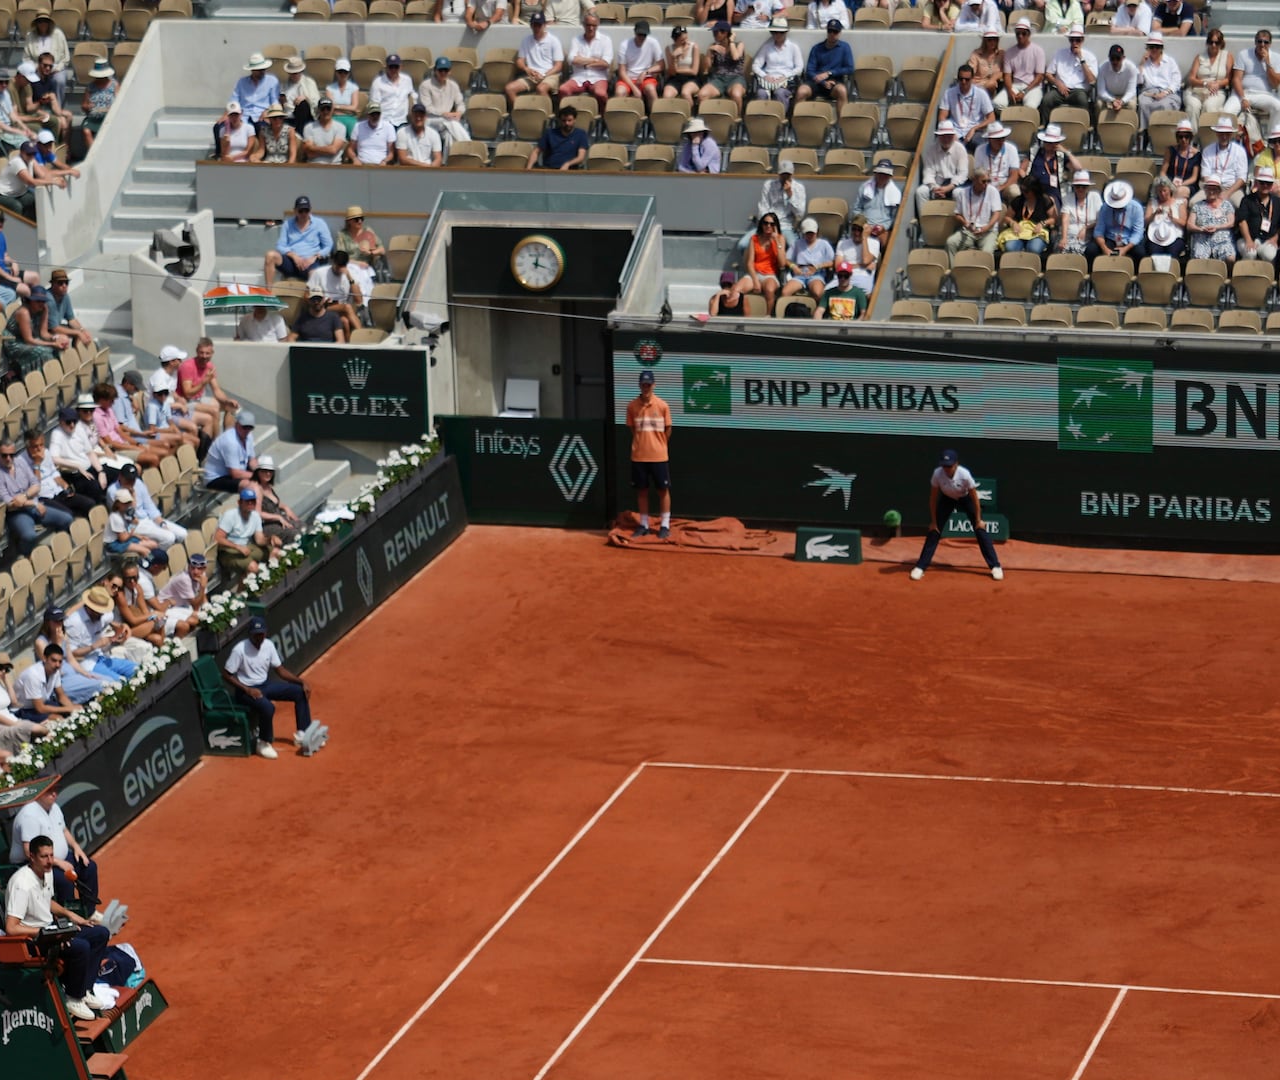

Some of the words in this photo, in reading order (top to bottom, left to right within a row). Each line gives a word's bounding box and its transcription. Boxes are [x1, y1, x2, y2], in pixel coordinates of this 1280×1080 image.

[307, 394, 411, 419] ROLEX
[744, 378, 812, 408] BNP
[820, 382, 961, 414] PARIBAS
[474, 428, 542, 458] Infosys
[1081, 490, 1140, 519] BNP
[1148, 494, 1272, 524] PARIBAS
[383, 492, 450, 572] RENAULT
[949, 519, 1000, 534] LACTE
[271, 580, 345, 662] RENAULT
